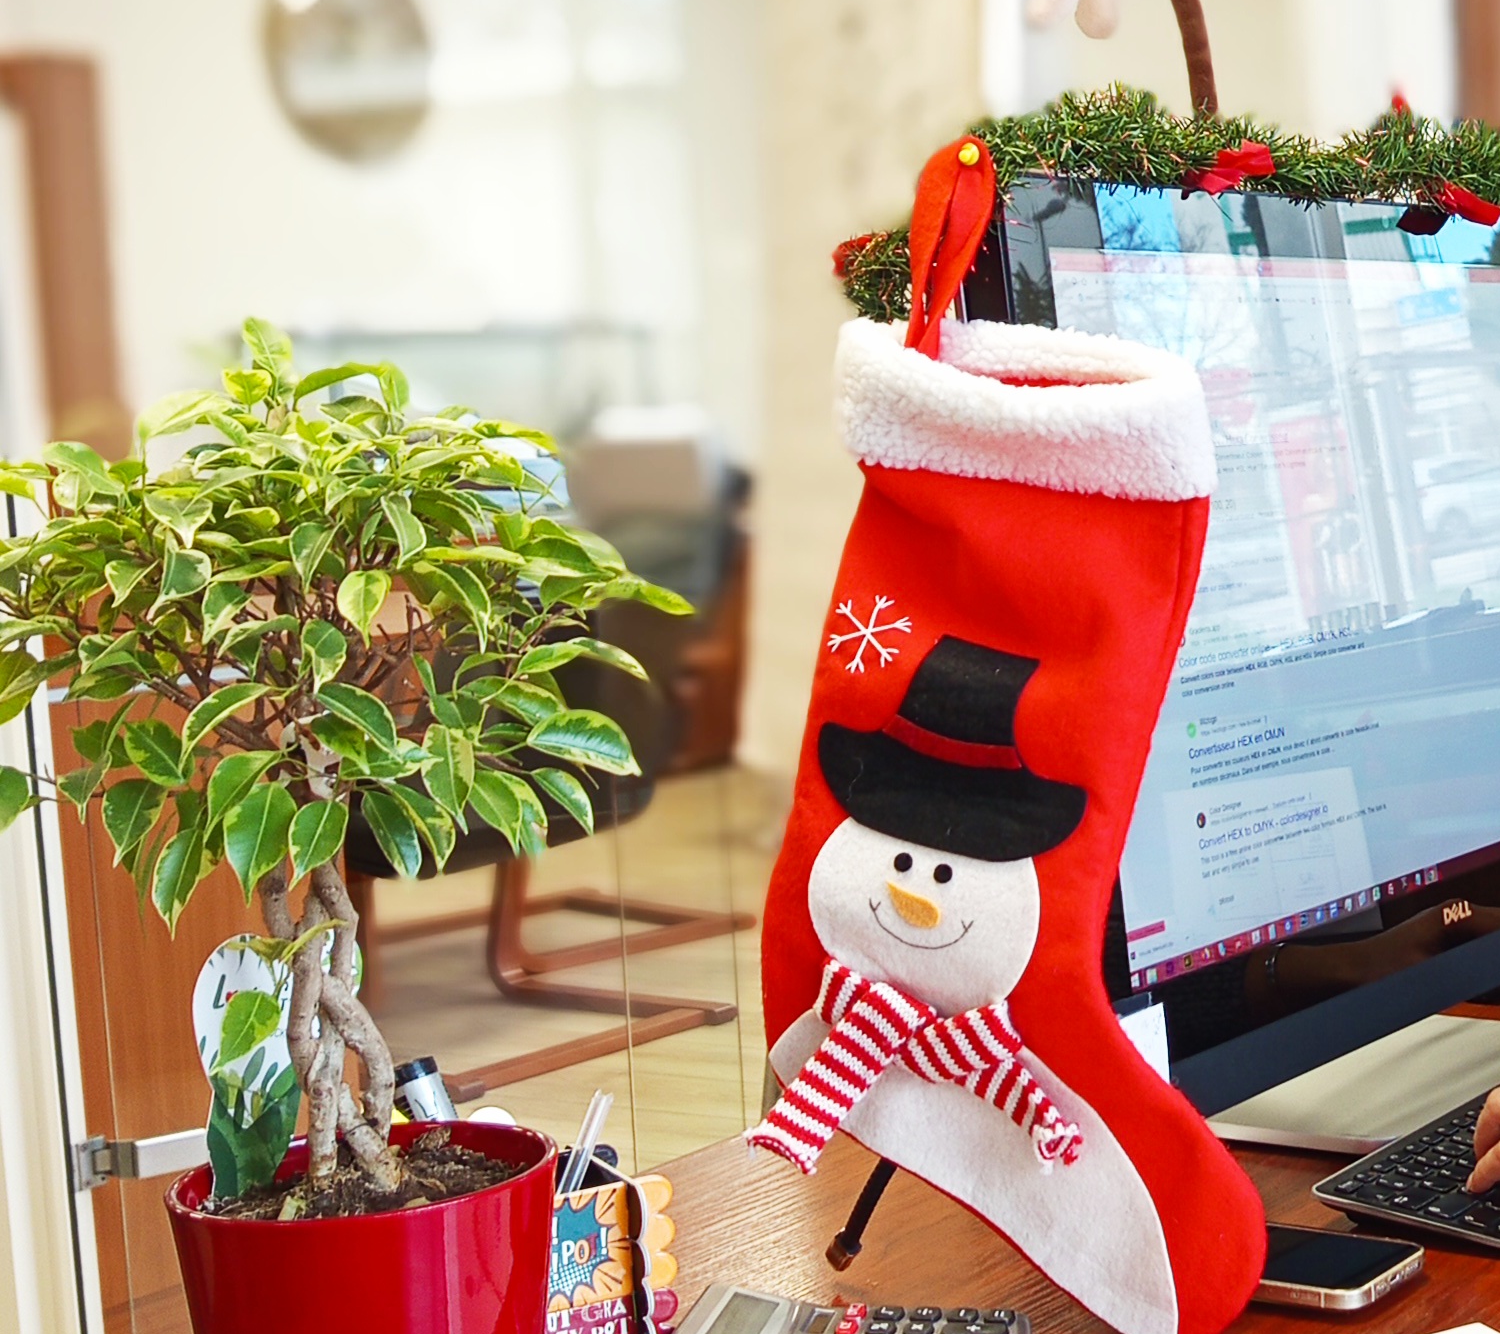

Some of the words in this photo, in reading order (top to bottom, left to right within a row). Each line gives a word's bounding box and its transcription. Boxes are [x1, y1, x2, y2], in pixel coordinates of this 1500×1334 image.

[1189, 740, 1236, 759] Convertisseur
[1238, 734, 1254, 747] HEX
[1254, 733, 1263, 744] en
[1199, 834, 1226, 850] Convert
[1228, 829, 1244, 841] HEX
[1245, 827, 1252, 836] to
[1253, 819, 1275, 834] CMYK
[1443, 900, 1472, 926] DELL
[547, 1308, 574, 1333] OT
